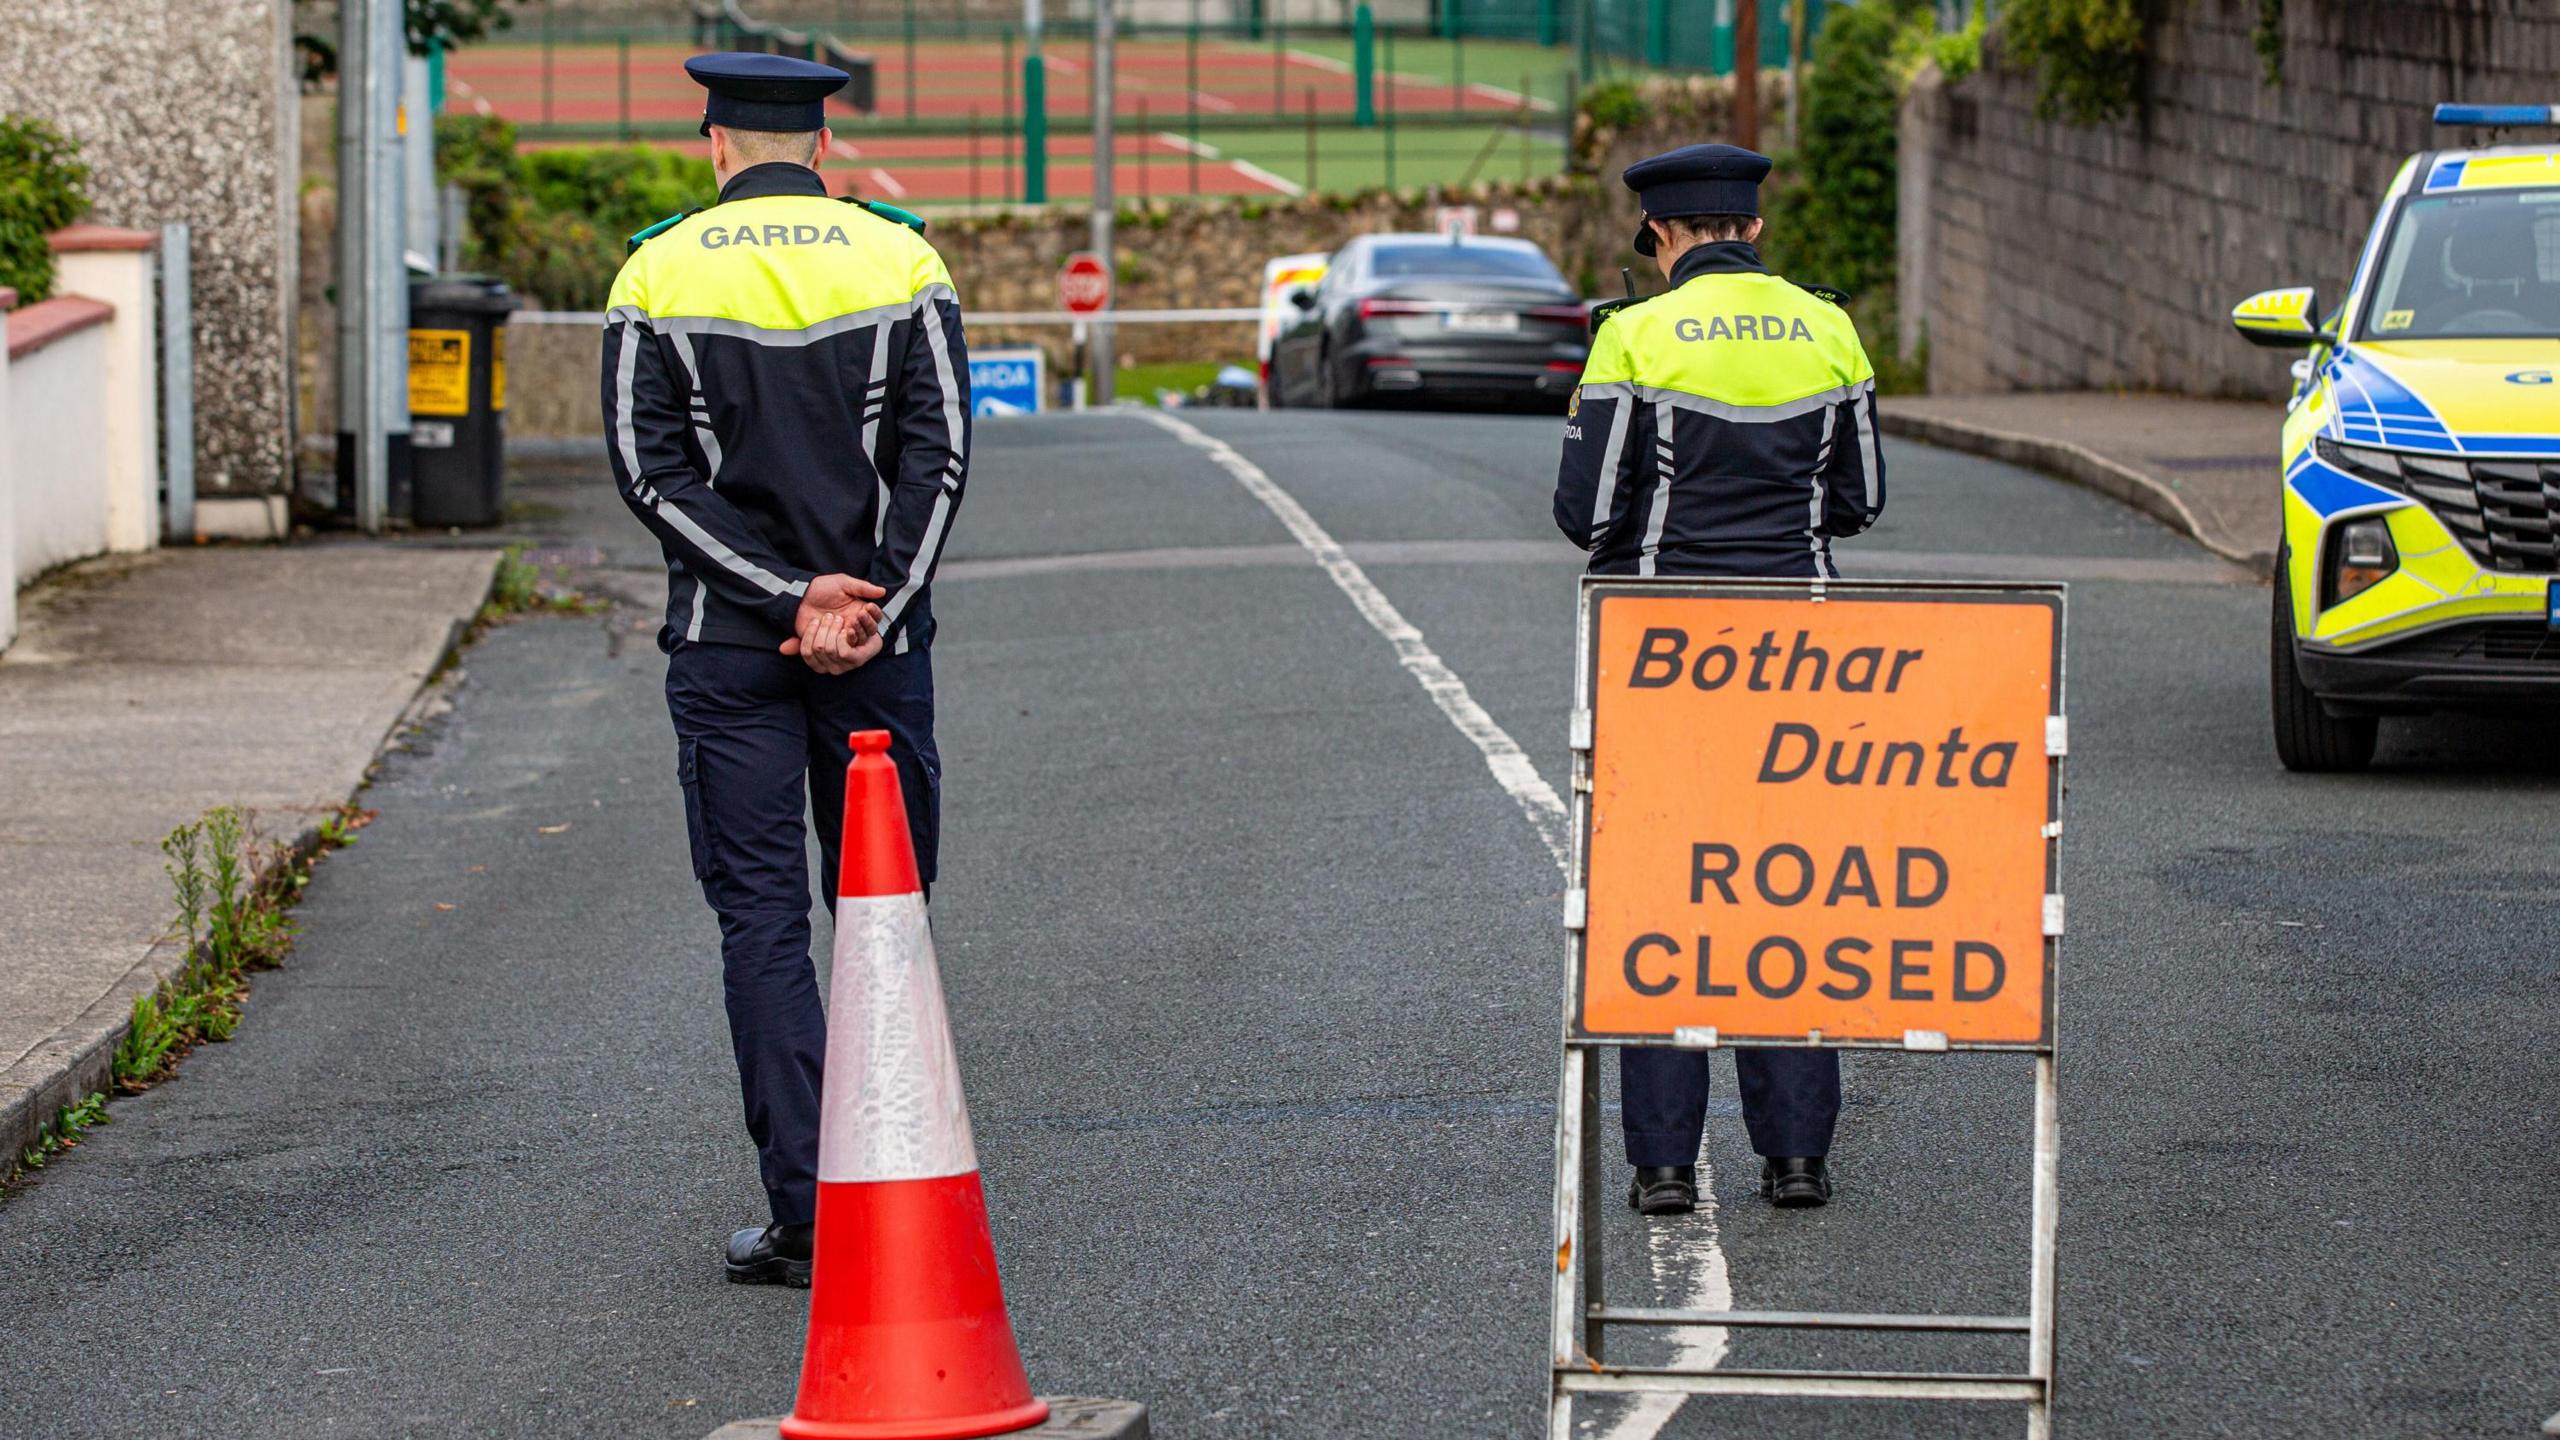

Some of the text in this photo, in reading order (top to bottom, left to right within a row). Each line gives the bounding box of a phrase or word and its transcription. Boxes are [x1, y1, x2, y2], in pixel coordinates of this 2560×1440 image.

[700, 224, 851, 250] GARDA
[1062, 273, 1106, 303] STOP
[1675, 315, 1815, 343] GARDA
[1628, 627, 1923, 693] Bóthar
[1757, 722, 2019, 788] Dúnta
[1691, 844, 1948, 907] ROAD
[1624, 934, 2005, 1001] CLOSED
